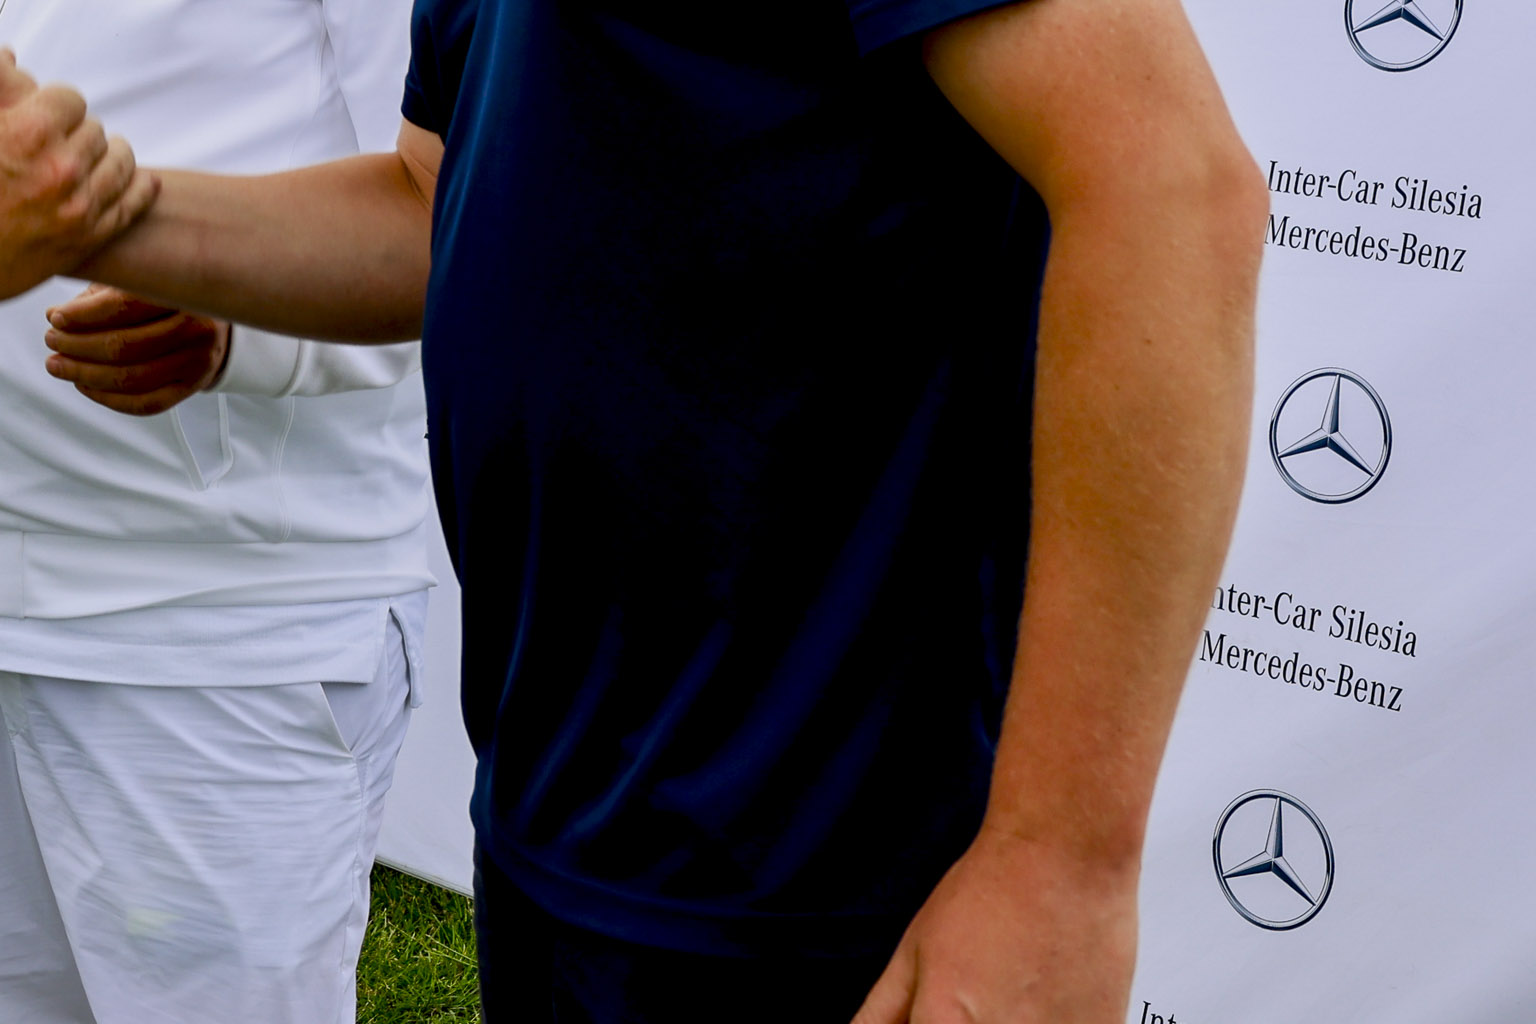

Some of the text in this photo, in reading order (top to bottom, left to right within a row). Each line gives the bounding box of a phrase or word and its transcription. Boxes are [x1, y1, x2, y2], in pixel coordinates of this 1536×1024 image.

[1268, 160, 1482, 219] Inter-Car Silesia
[1265, 214, 1467, 273] Mercedes-Benz
[1210, 584, 1417, 658] nter-Car Silesia
[1199, 629, 1403, 712] Mercedes-Benz
